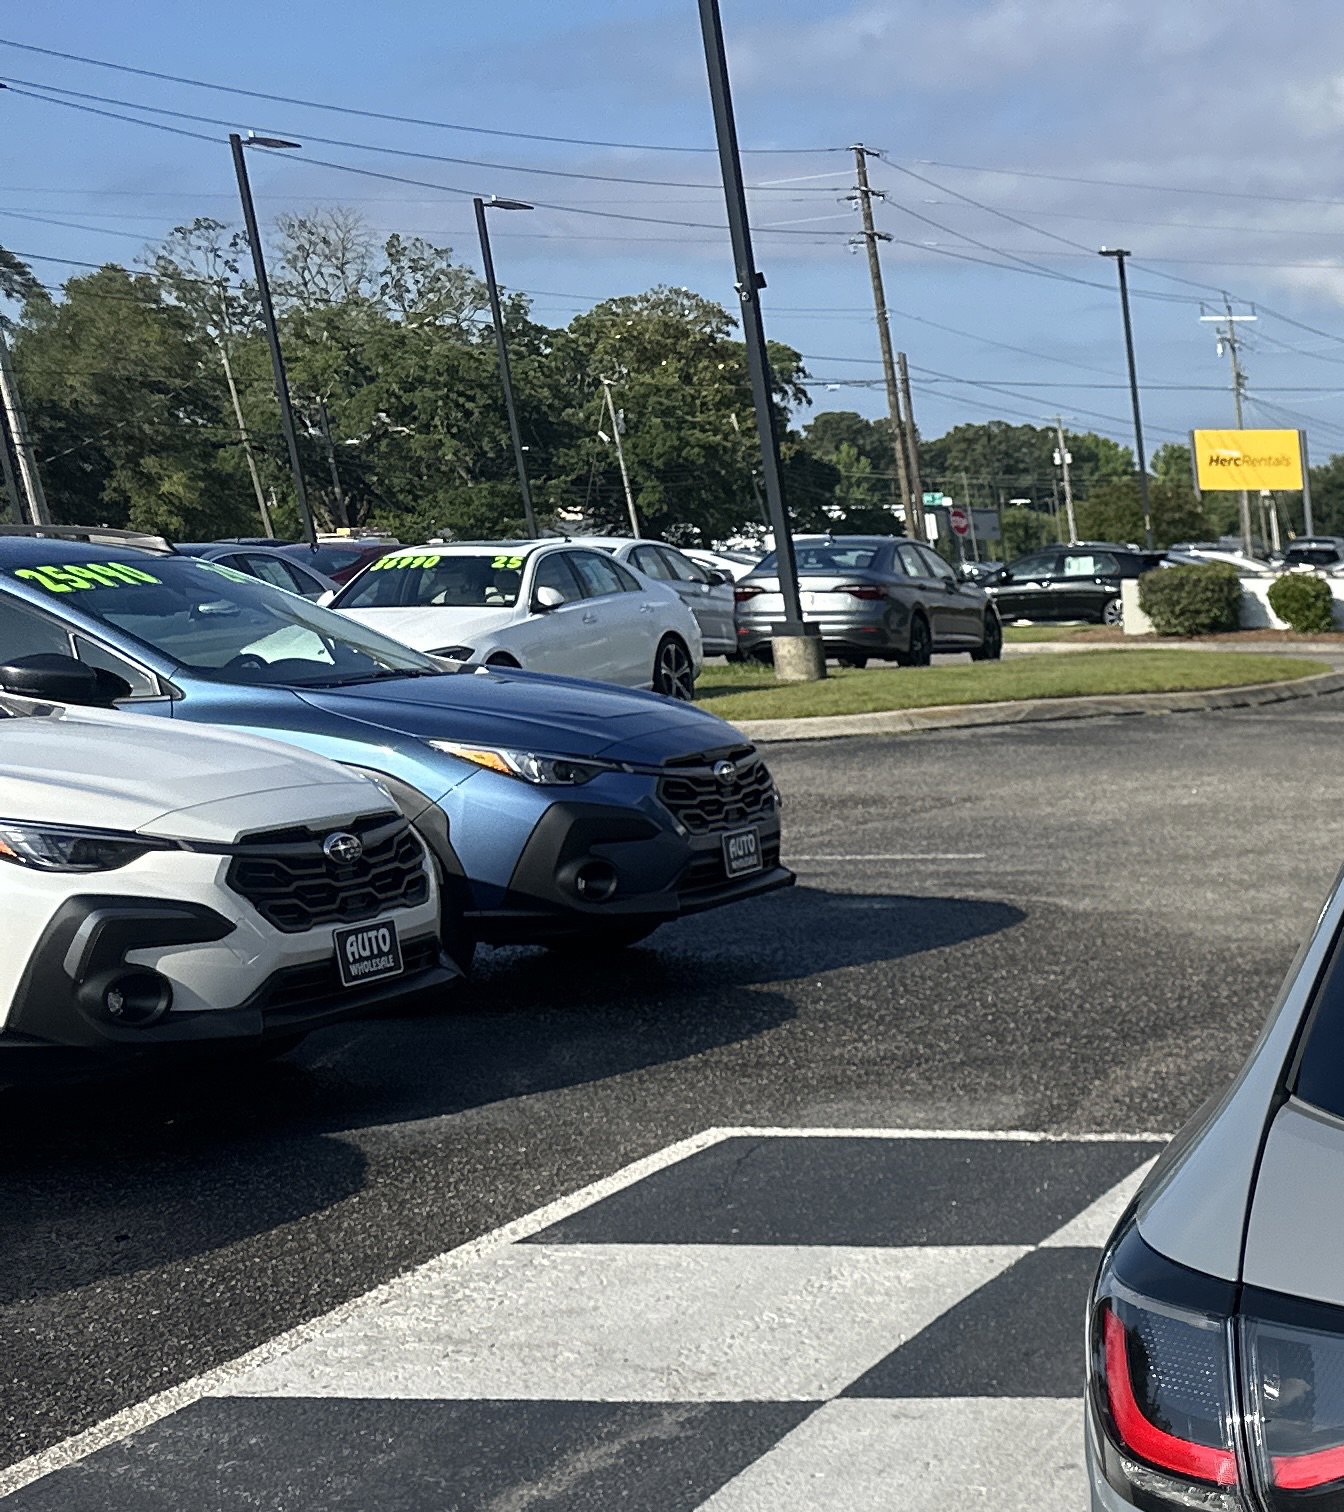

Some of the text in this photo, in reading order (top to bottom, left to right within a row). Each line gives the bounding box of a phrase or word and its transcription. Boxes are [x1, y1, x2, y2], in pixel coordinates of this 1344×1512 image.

[491, 556, 524, 569] 25
[14, 561, 163, 593] 25990
[729, 833, 756, 859] AUTO
[345, 927, 391, 963] AUTO
[349, 955, 395, 976] WHOLESALE
